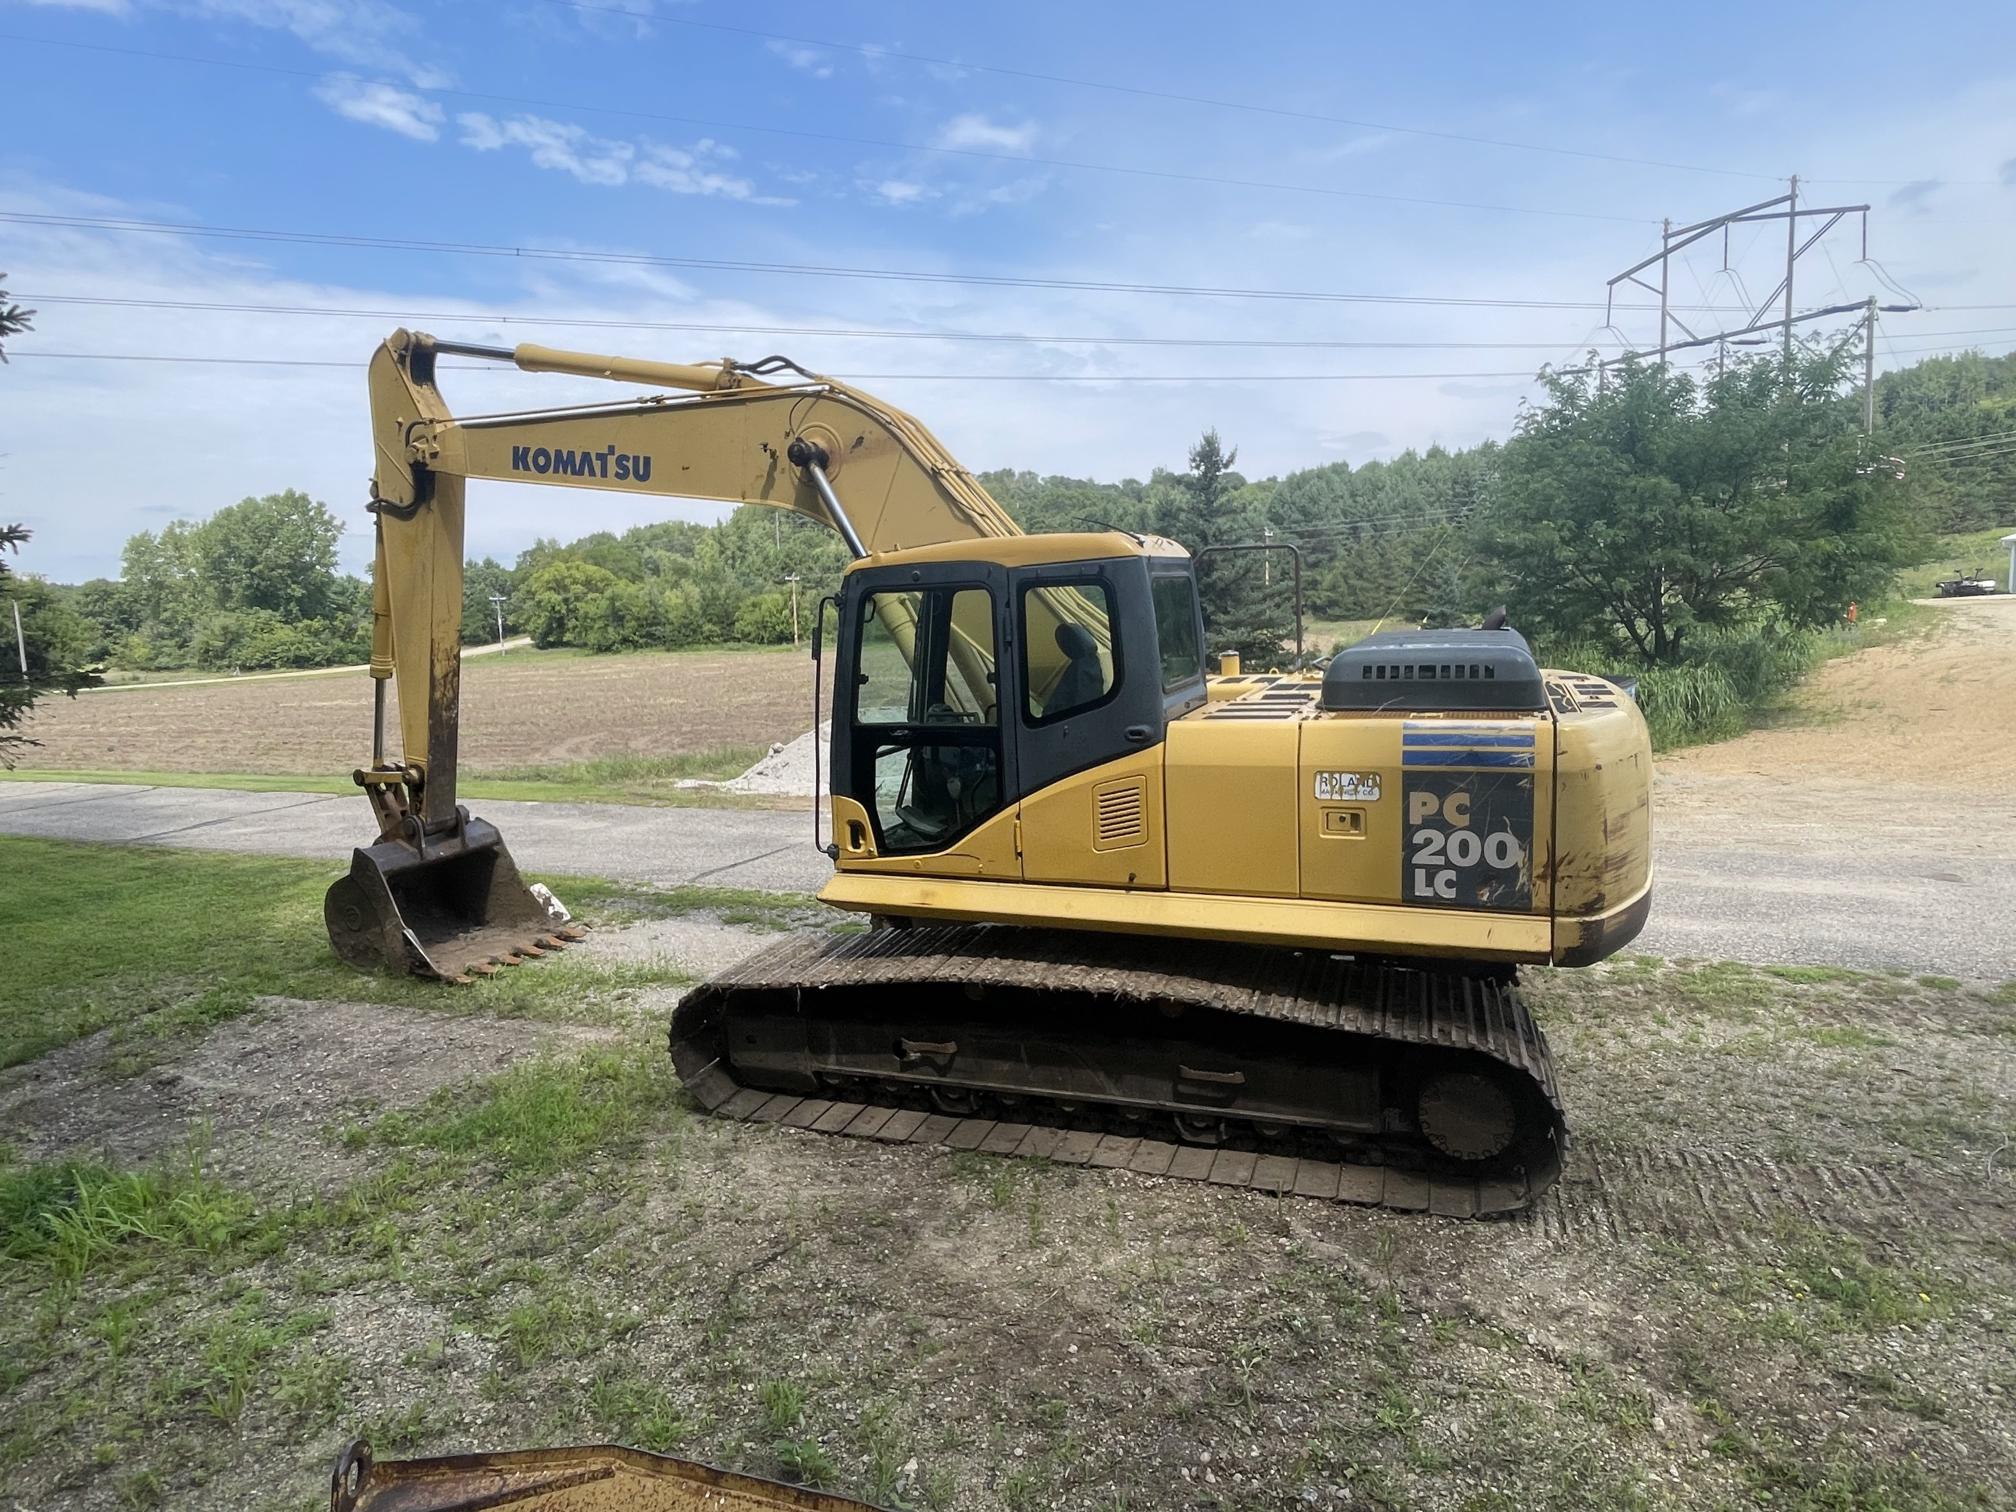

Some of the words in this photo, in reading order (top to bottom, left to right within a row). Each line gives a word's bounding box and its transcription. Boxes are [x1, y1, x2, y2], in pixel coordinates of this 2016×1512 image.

[512, 444, 652, 482] KOMATSU
[1409, 791, 1470, 828] PC
[1411, 828, 1520, 869] 200
[1414, 868, 1456, 899] LC
